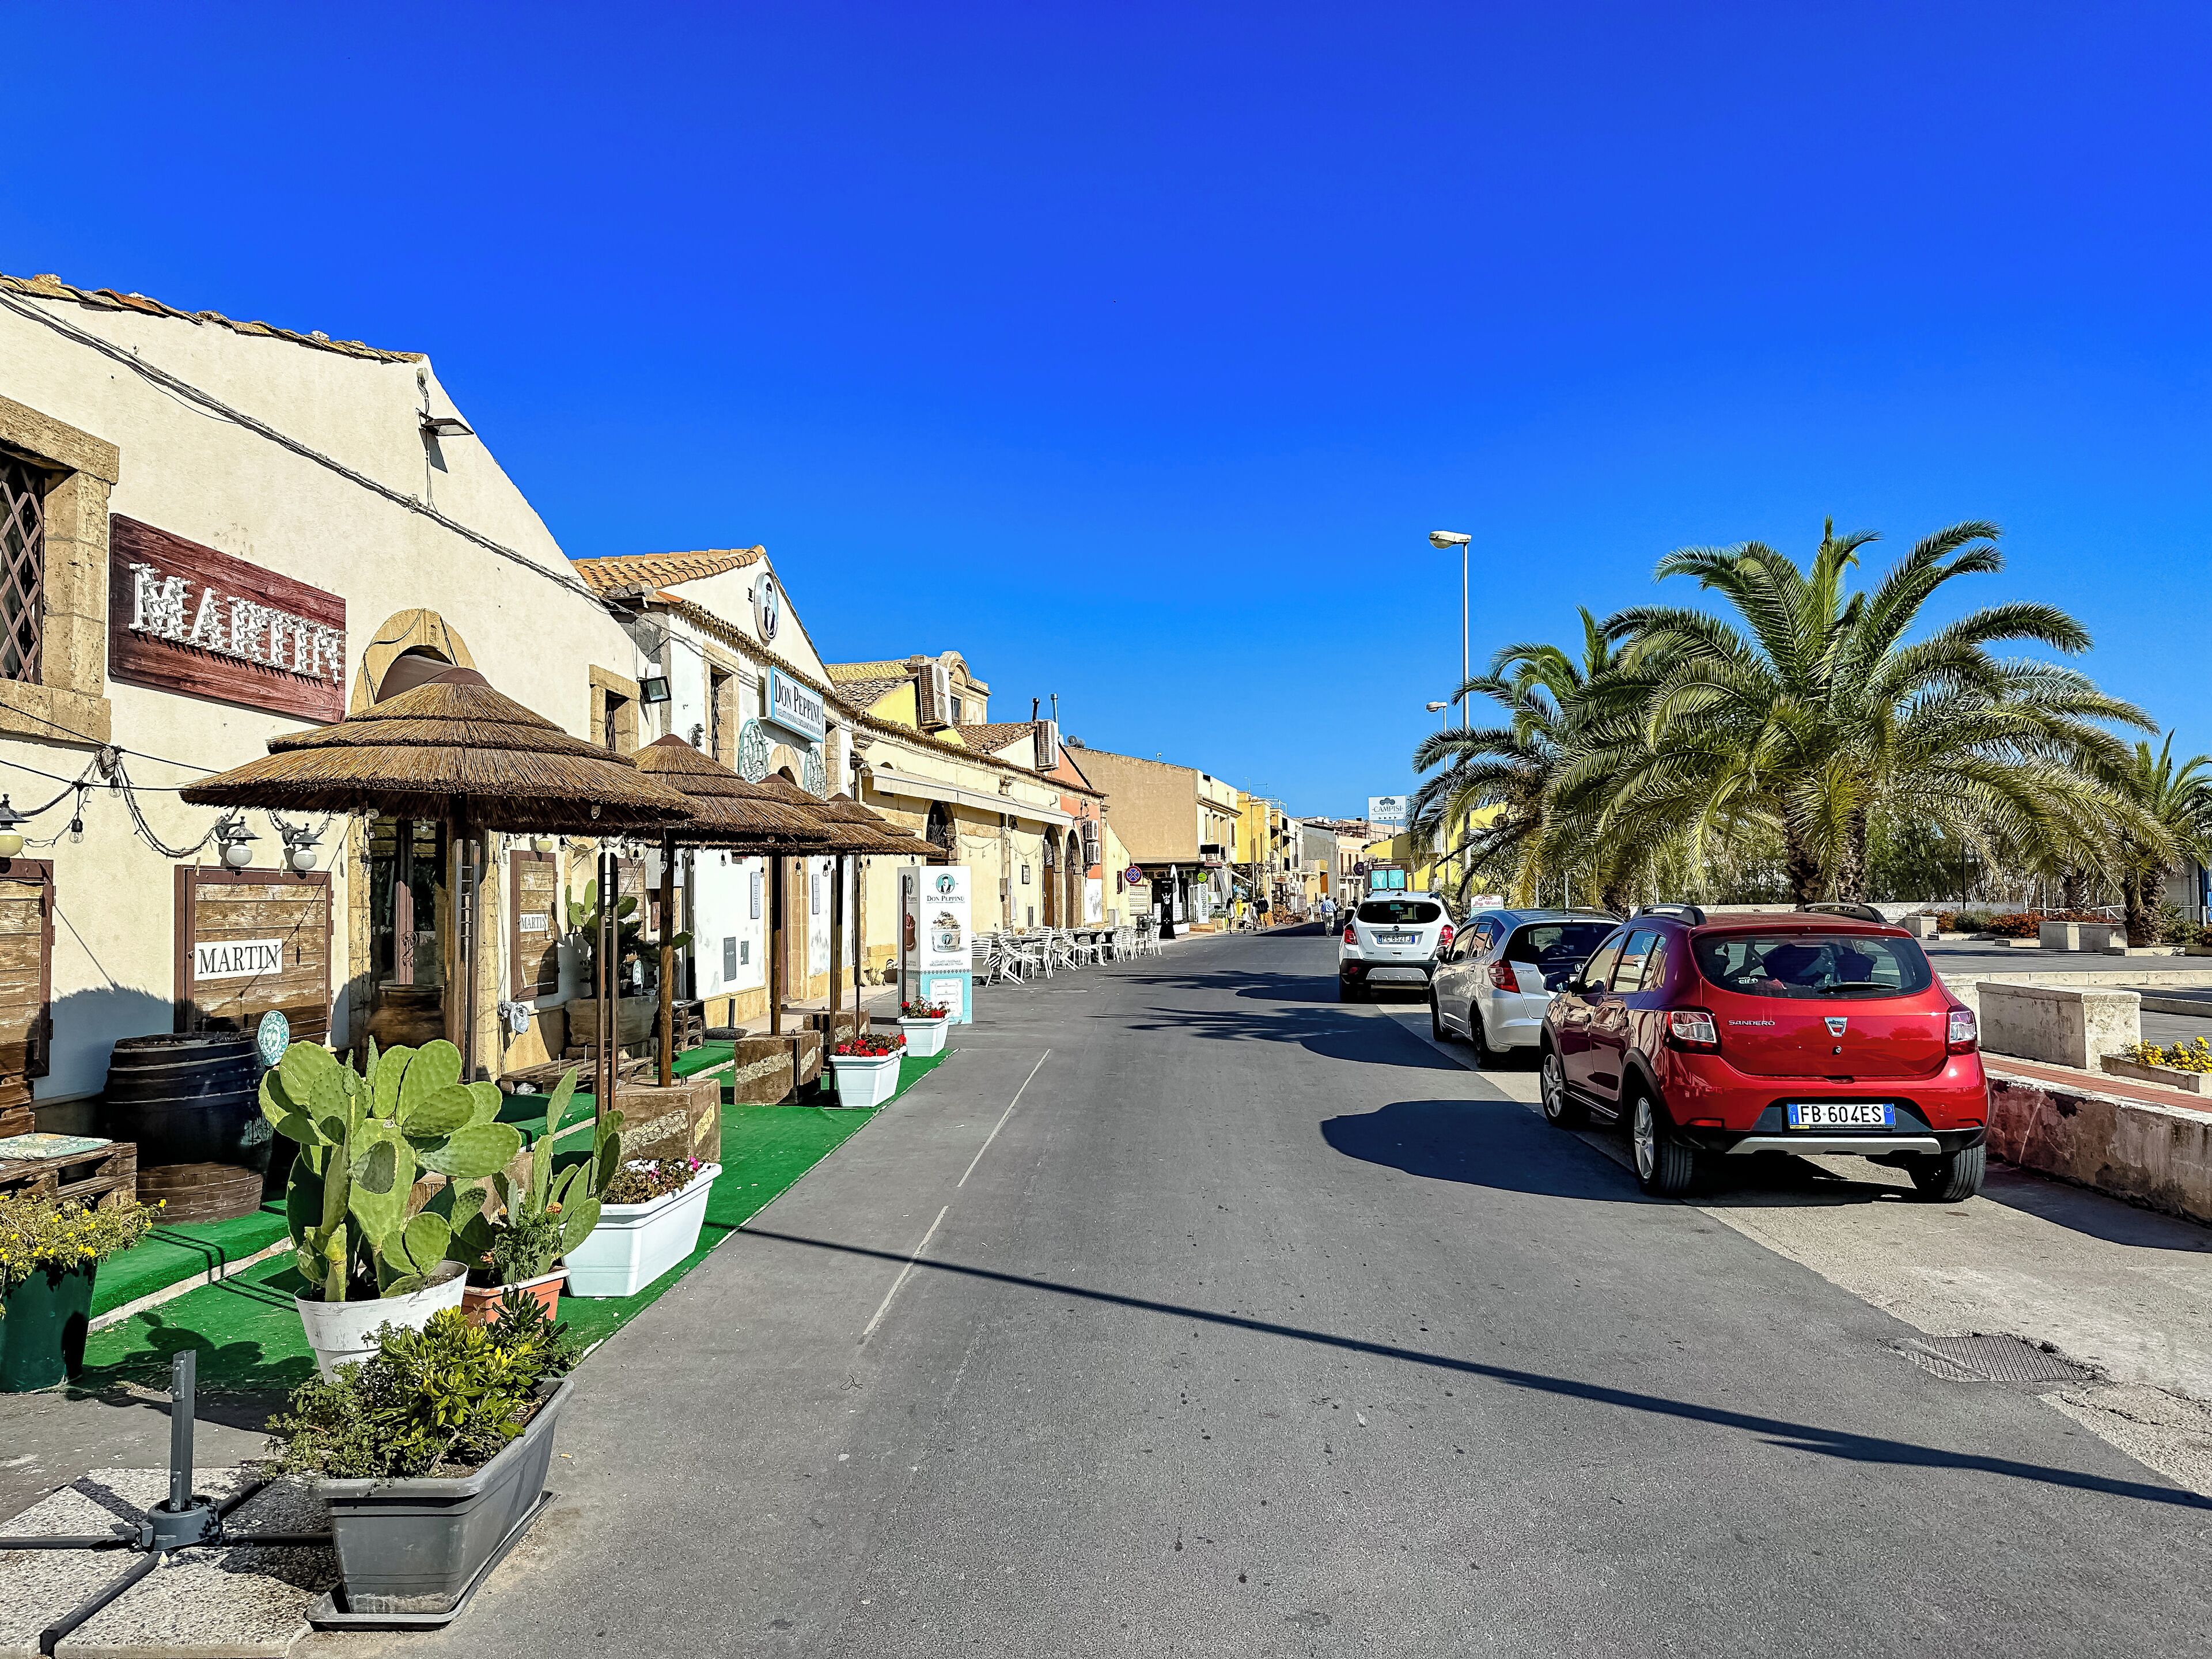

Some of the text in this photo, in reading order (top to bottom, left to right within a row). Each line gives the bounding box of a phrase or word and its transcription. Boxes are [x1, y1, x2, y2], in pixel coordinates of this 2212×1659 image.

[128, 563, 346, 684] MARTIN
[774, 674, 822, 725] DON PEPPINU
[521, 916, 547, 929] MARTIN
[198, 945, 279, 974] MARTIN
[1800, 1106, 1821, 1123] FB
[1828, 1106, 1882, 1123] 604ES
